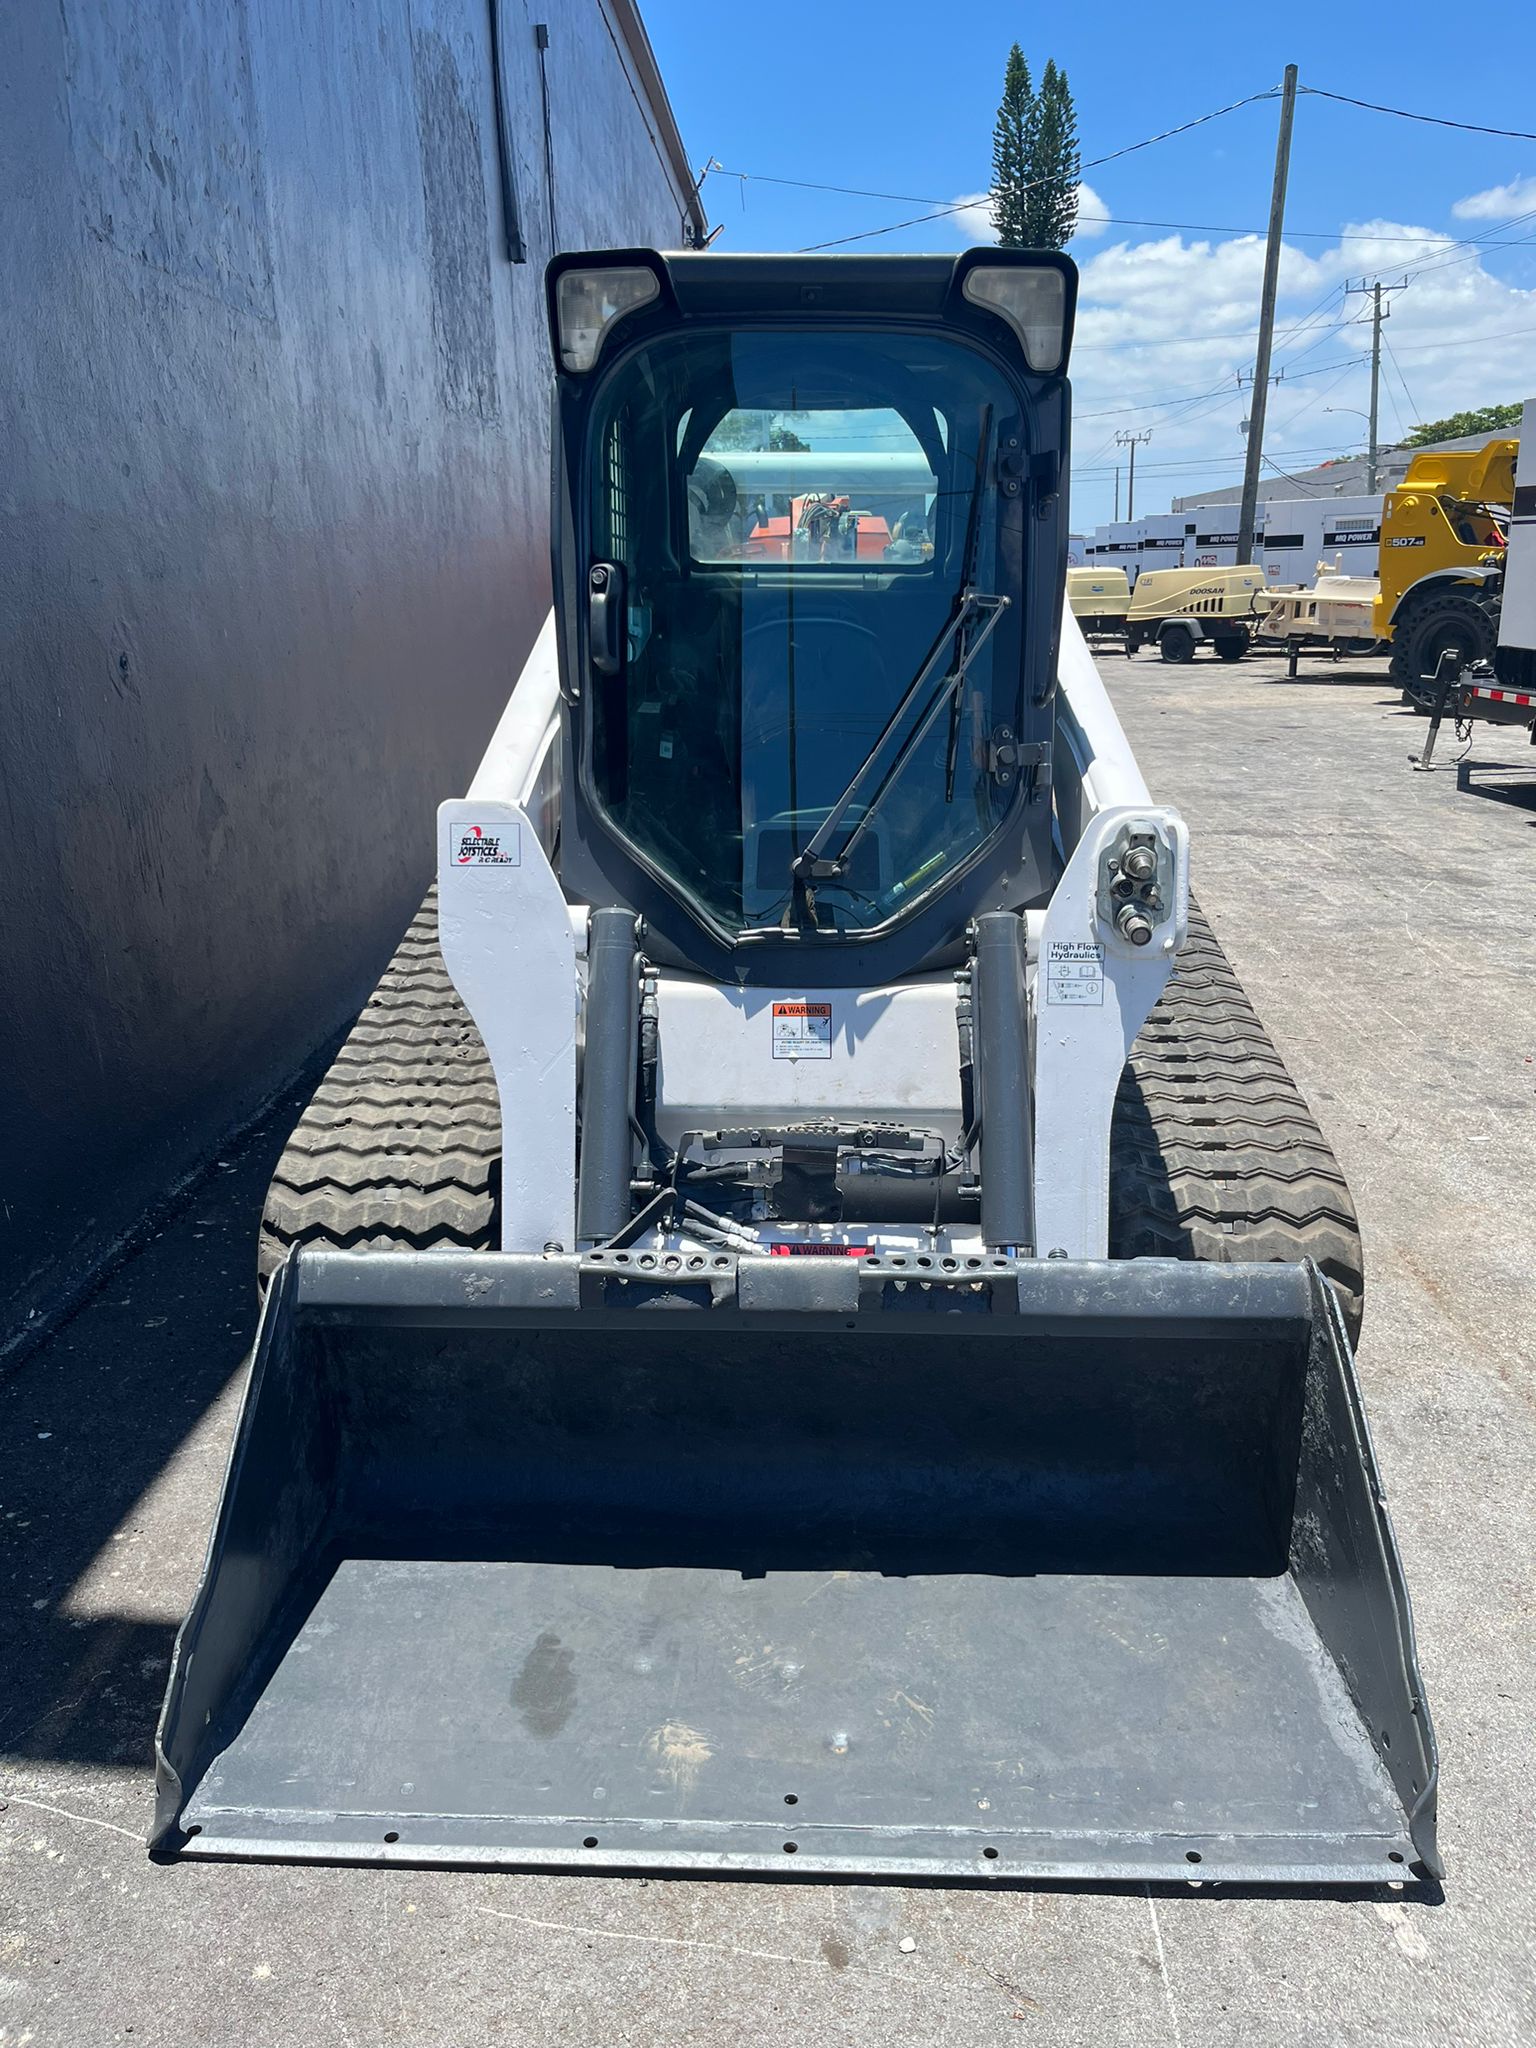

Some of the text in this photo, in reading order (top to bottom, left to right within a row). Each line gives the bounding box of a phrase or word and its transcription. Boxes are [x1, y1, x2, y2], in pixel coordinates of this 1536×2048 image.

[1335, 533, 1373, 542] MQ POWER
[1189, 587, 1225, 595] DOOSAN
[461, 837, 500, 846] SELECTABLE
[458, 846, 499, 857] JOYSTICKS
[1053, 943, 1075, 952] High
[1051, 951, 1101, 960] Hydraulics
[788, 1006, 826, 1015] WARNING
[804, 1245, 851, 1255] WARNING
